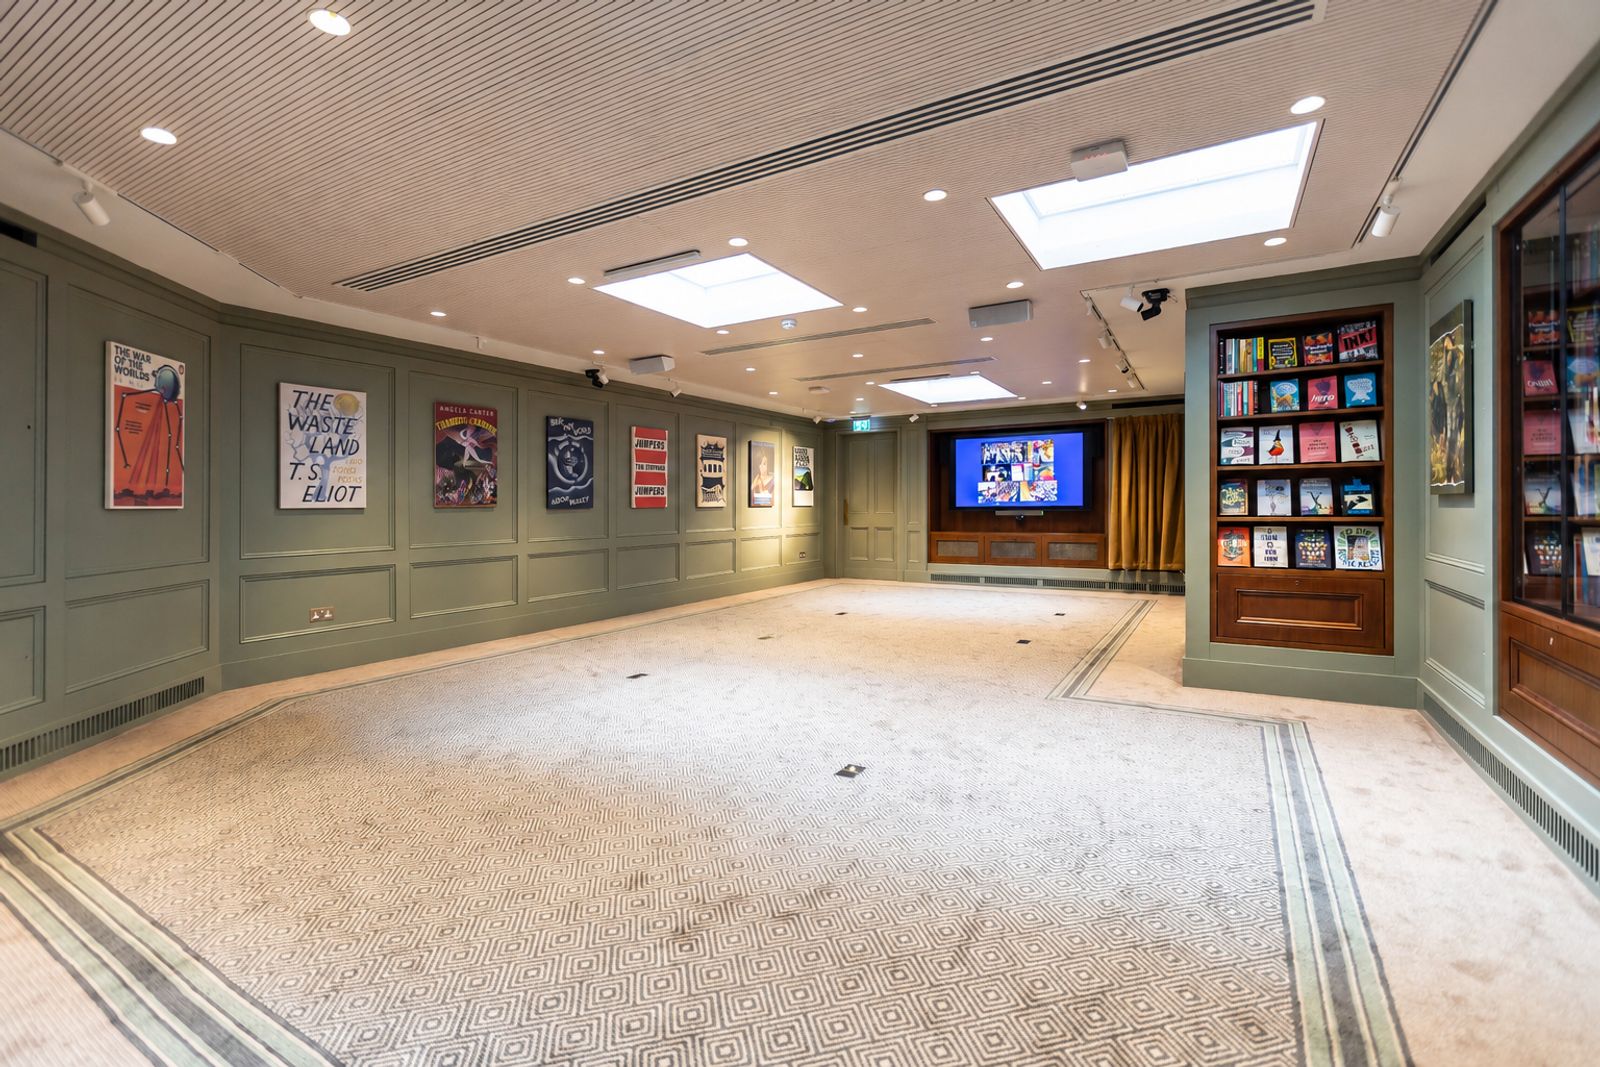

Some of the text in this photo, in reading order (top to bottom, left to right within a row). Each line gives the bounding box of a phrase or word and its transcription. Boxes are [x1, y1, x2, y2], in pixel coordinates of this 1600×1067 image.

[115, 345, 152, 364] THE WAR
[115, 355, 143, 371] OF THE
[114, 364, 150, 382] WORLDS
[293, 390, 334, 411] THE
[439, 405, 494, 417] ANGELA CARTER
[288, 412, 358, 435] WASTE
[309, 437, 360, 456] LAND
[635, 439, 665, 450] JUMPERS
[302, 486, 362, 503] ELIOT
[635, 486, 665, 496] JUMPERS
